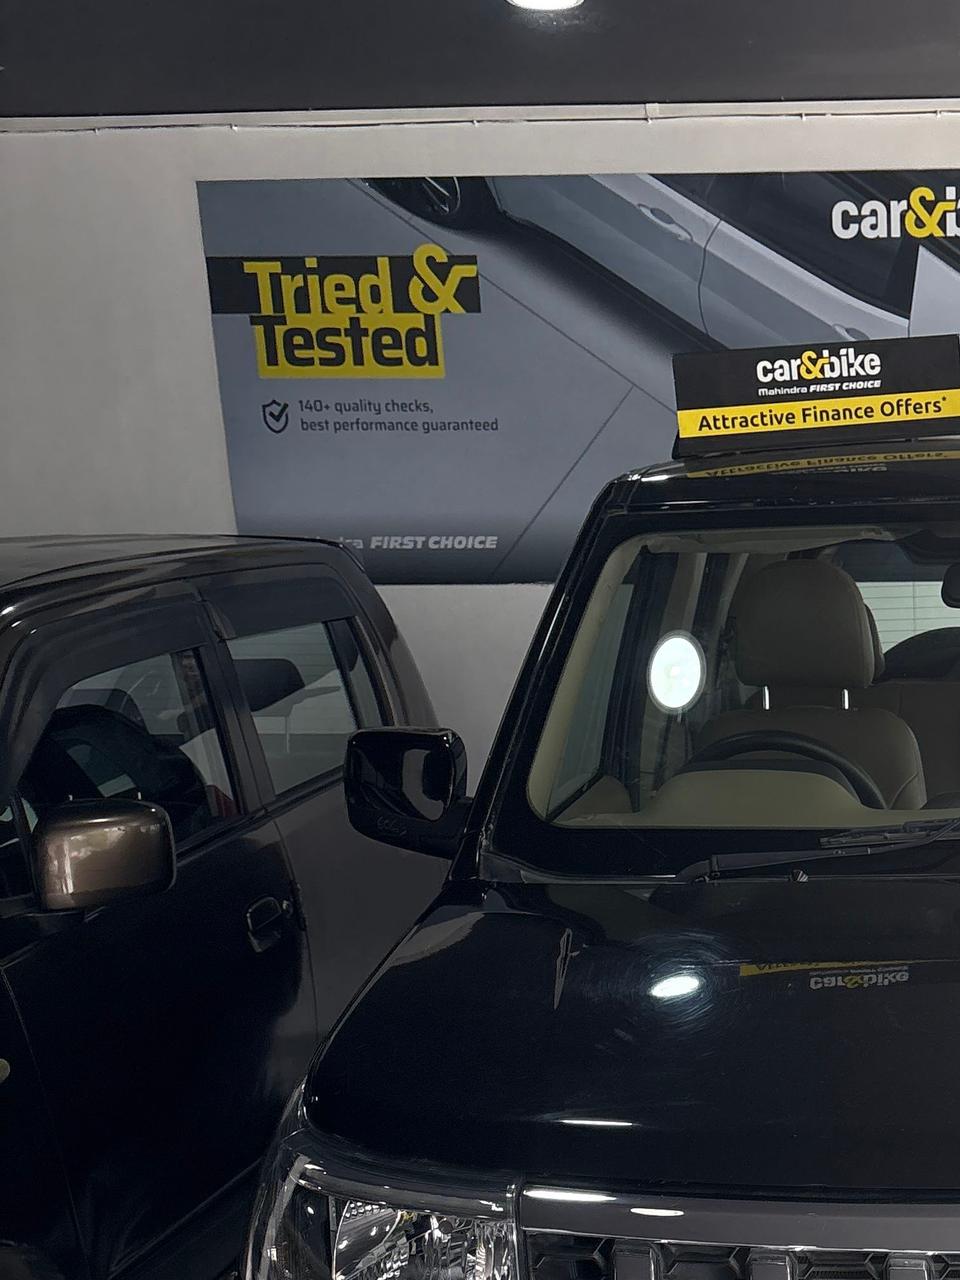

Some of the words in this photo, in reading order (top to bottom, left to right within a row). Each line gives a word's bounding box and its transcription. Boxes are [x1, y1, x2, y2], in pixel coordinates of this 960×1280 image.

[243, 257, 394, 315] Tried
[407, 243, 478, 314] &
[249, 314, 441, 367] Tested
[755, 347, 881, 384] car&bike
[758, 385, 808, 397] Mahindra
[808, 382, 841, 393] FIRST
[842, 379, 881, 391] CHOICE
[298, 400, 331, 413] 140+
[334, 399, 382, 416] quality
[384, 399, 434, 415] checks,
[698, 408, 797, 432] Attractive
[801, 403, 876, 423] Finance
[300, 418, 331, 432] best
[333, 418, 420, 434] performance
[422, 418, 499, 434] guaranteed
[369, 535, 426, 549] FIRST
[428, 535, 498, 549] CHOICE
